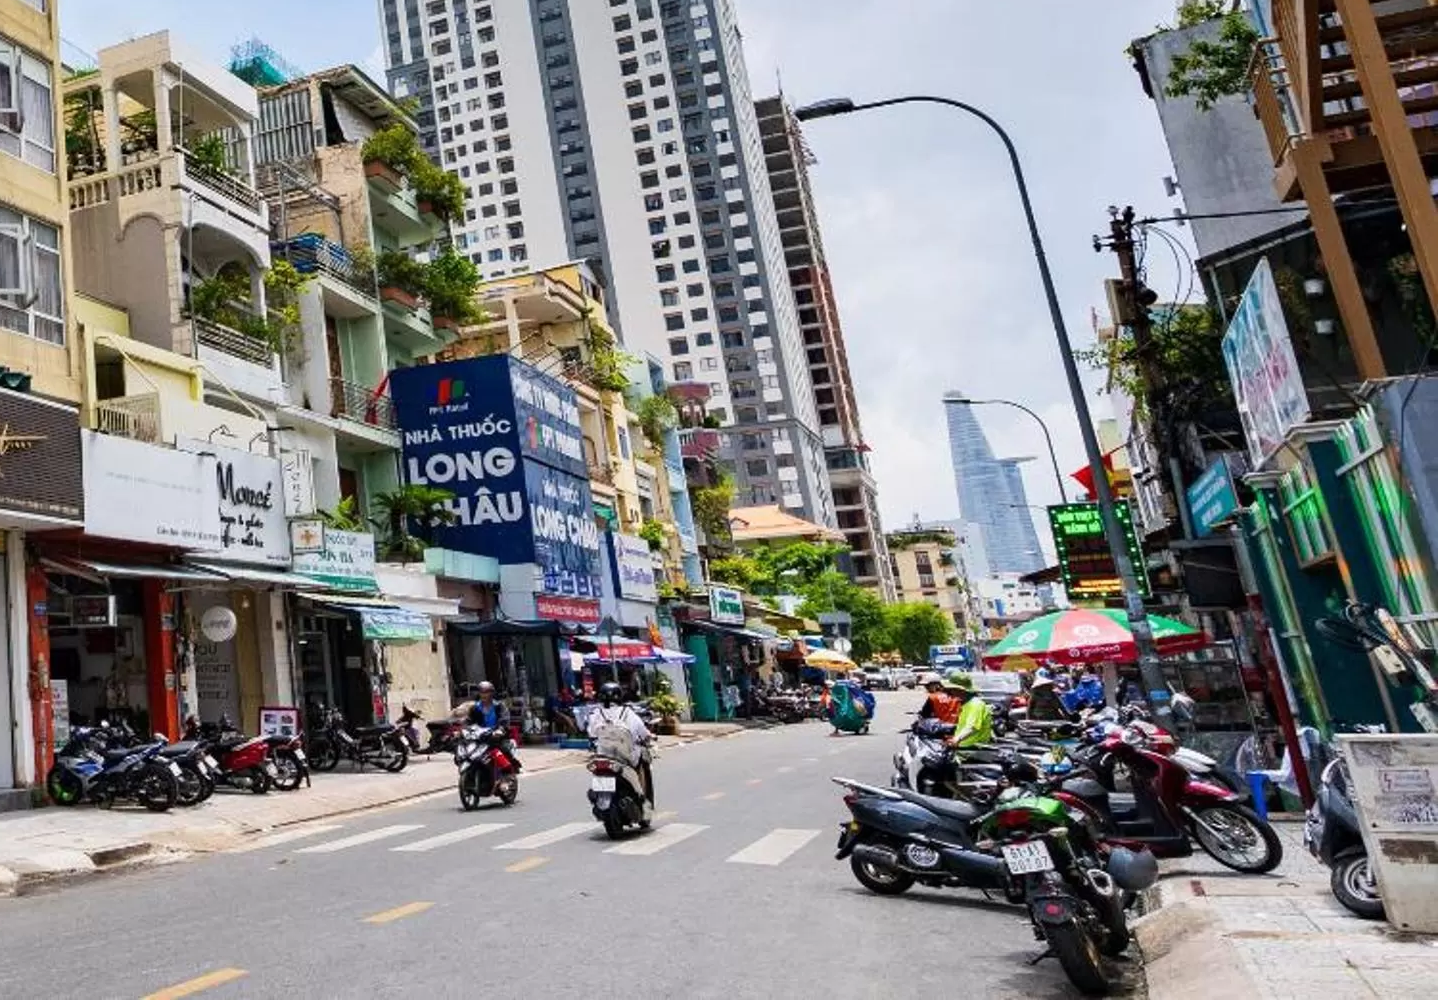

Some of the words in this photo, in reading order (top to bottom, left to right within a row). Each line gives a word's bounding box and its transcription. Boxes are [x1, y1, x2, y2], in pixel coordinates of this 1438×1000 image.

[405, 424, 442, 446] NHÀ
[448, 413, 511, 440] THUỐC
[408, 447, 516, 486] LONG
[415, 486, 523, 528] HÂU
[530, 503, 567, 542] LONG
